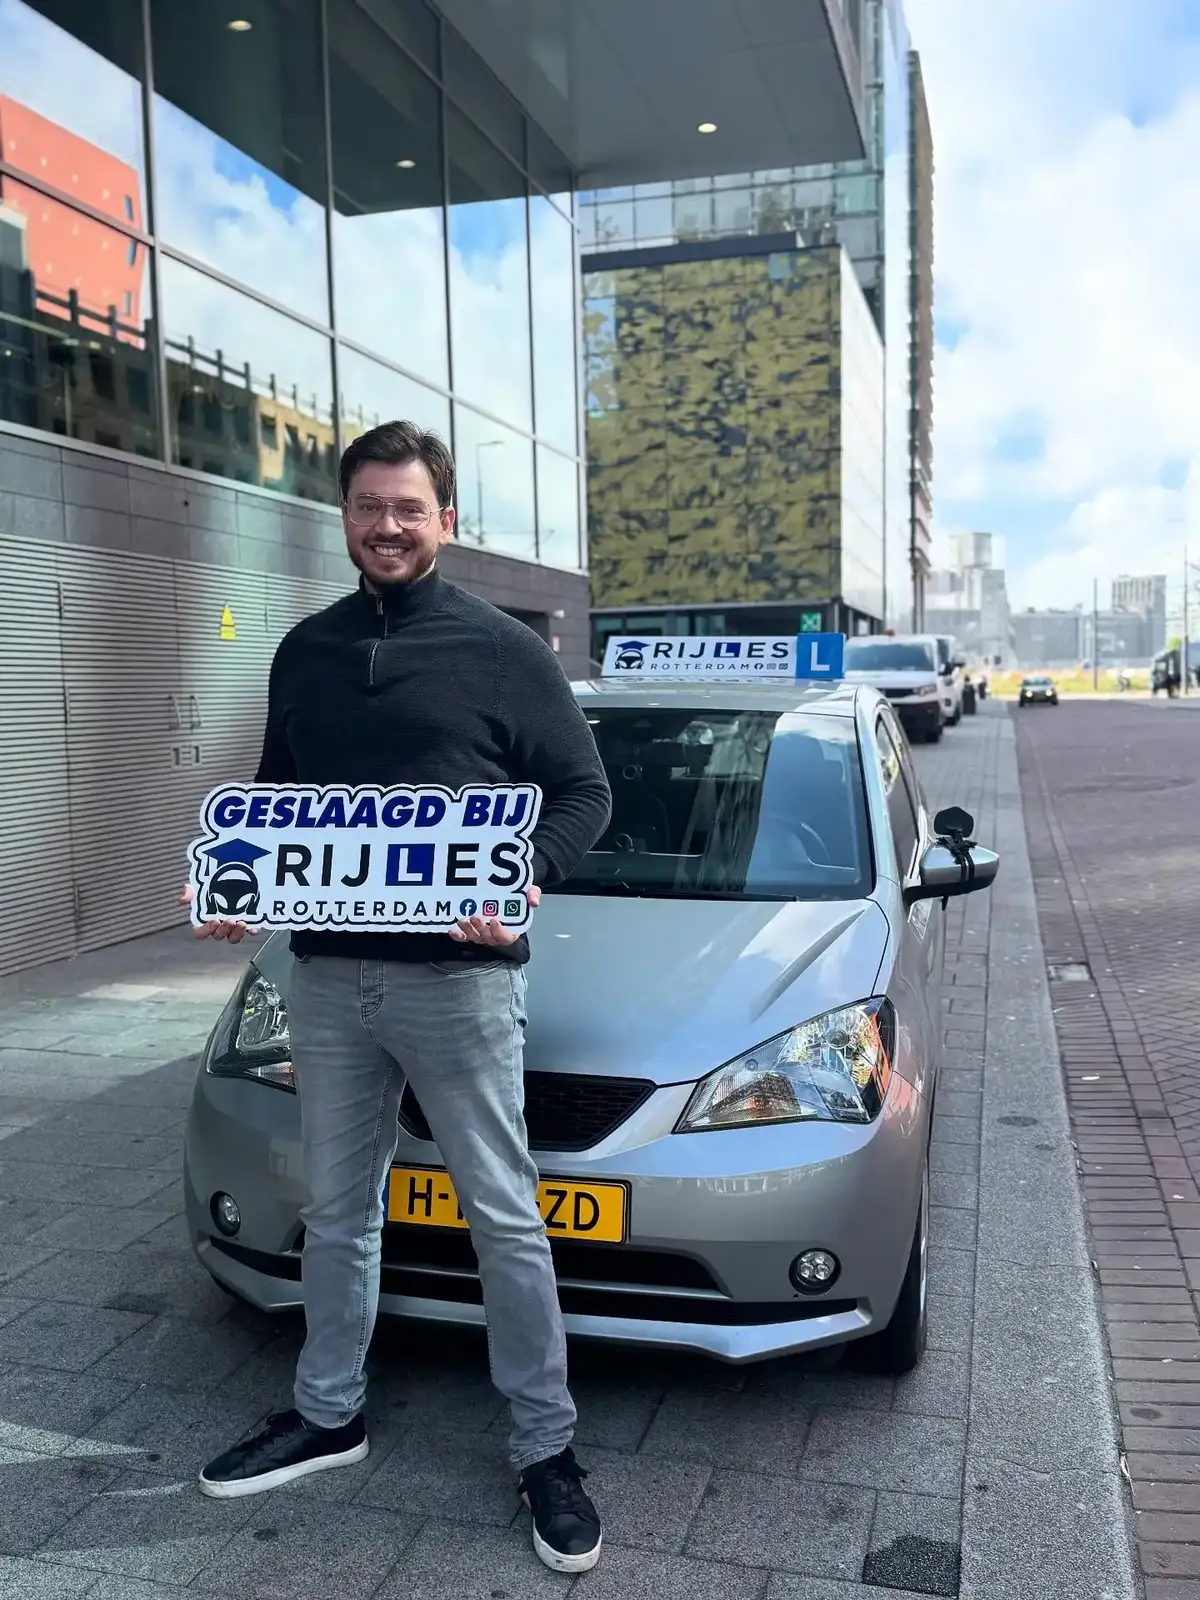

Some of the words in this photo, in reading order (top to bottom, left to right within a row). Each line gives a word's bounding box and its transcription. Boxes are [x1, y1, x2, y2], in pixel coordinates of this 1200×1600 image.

[653, 641, 789, 658] RIJLES
[810, 642, 830, 671] L
[213, 795, 447, 828] GESLAAGD
[461, 793, 528, 827] BIJ
[275, 842, 521, 887] RIJLES
[273, 900, 451, 916] ROTTERDAM
